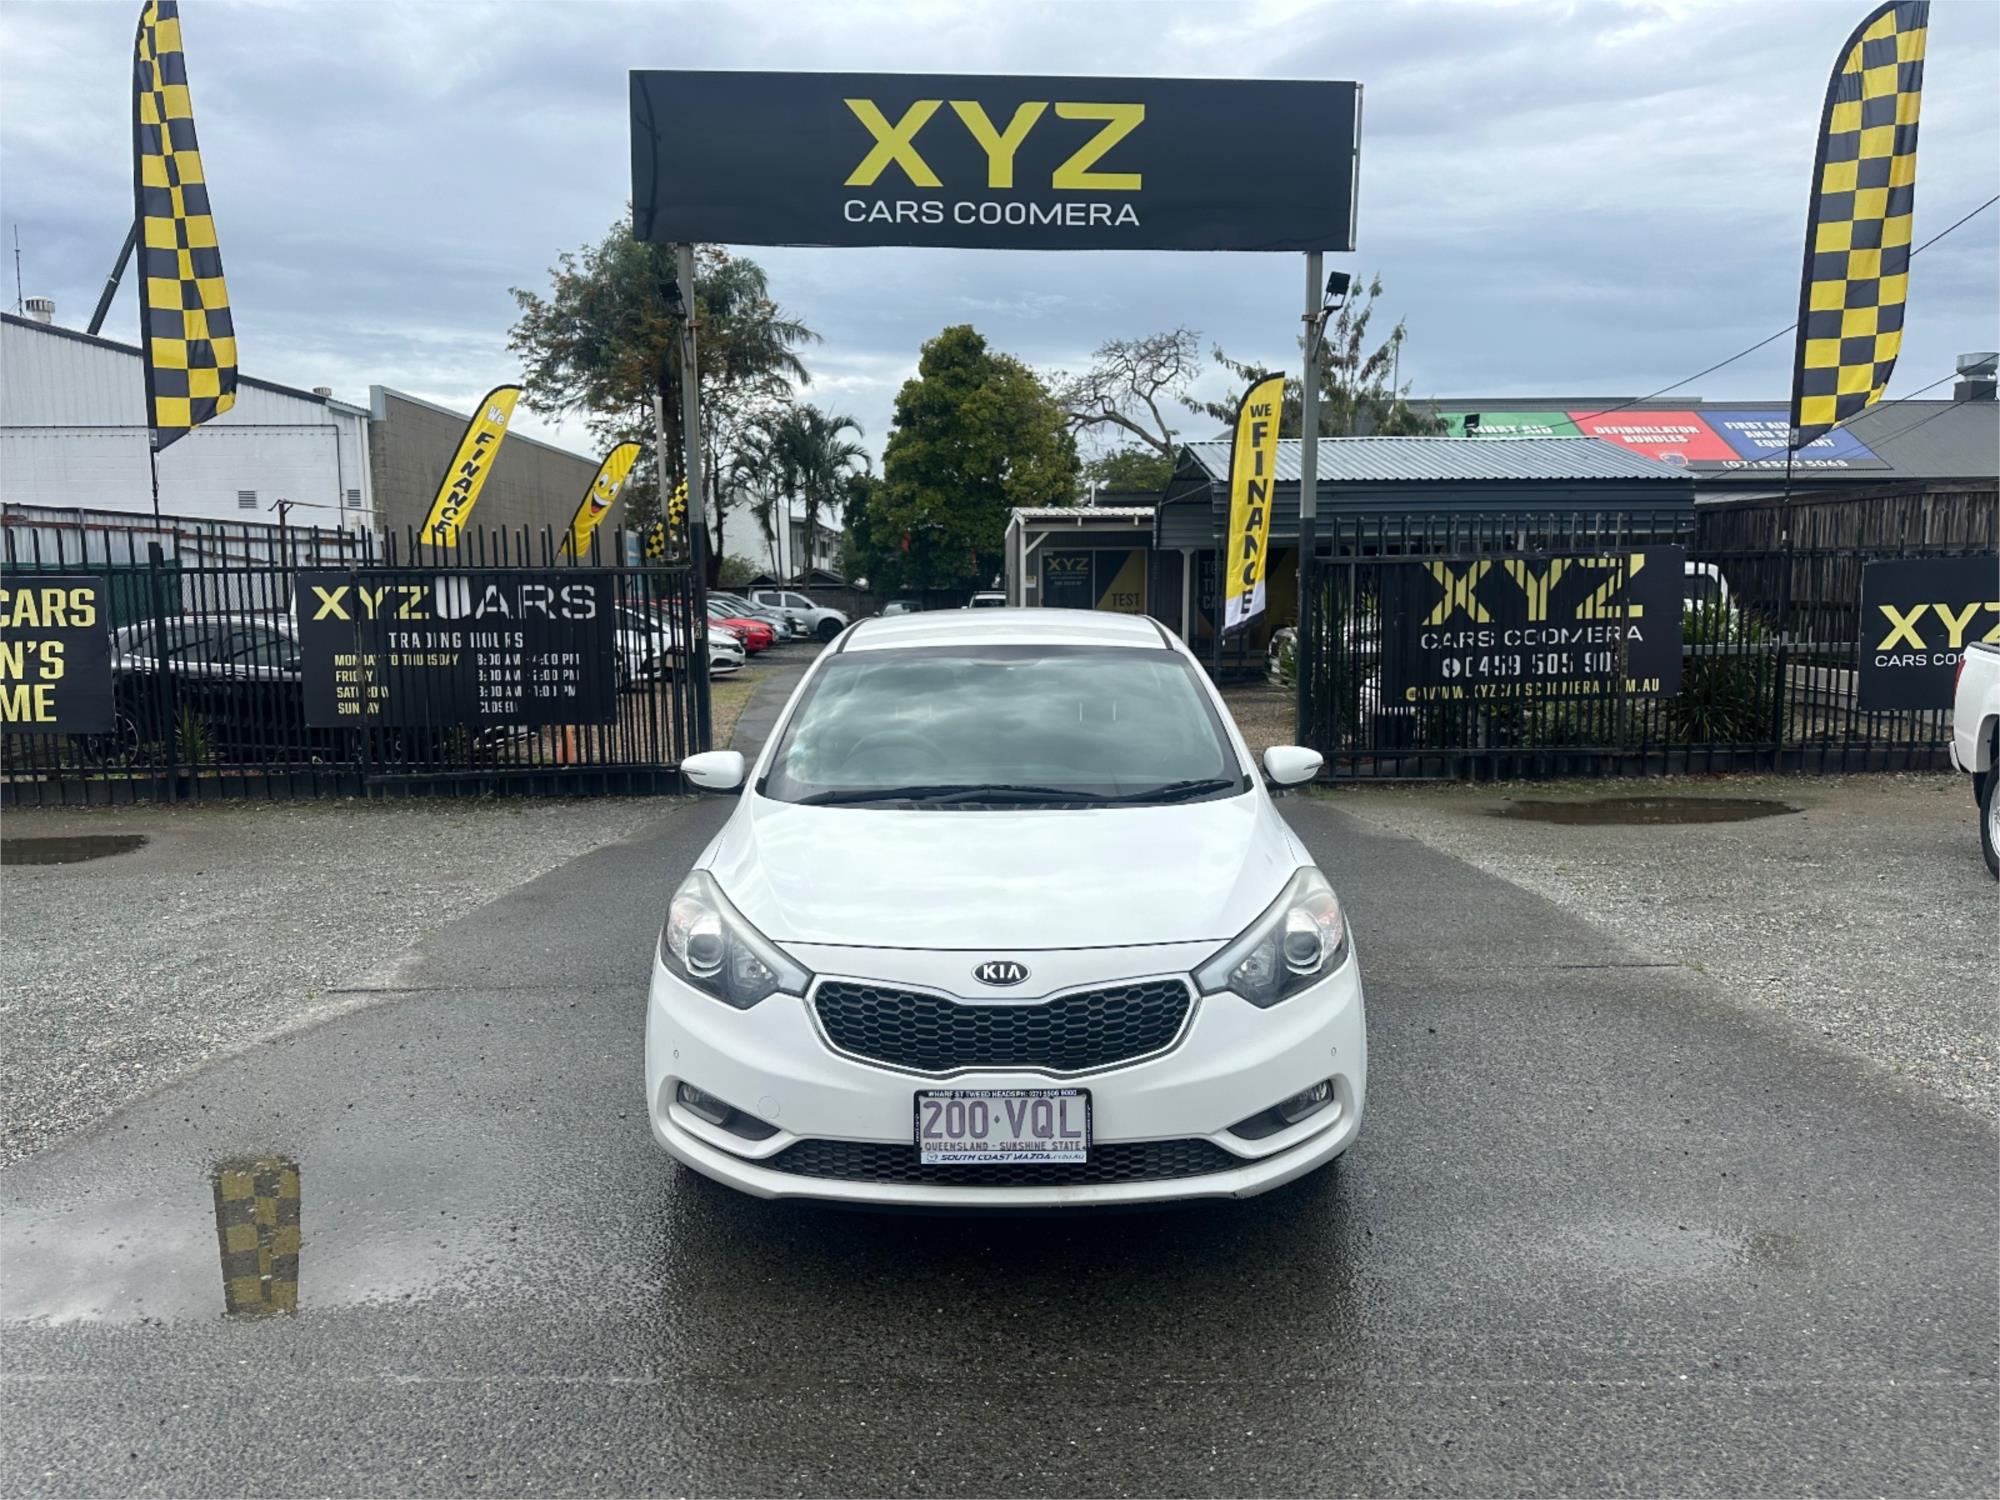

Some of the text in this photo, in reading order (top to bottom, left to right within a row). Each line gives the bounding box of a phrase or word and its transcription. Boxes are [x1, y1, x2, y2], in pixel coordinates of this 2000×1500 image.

[843, 98, 1146, 190] XYZ
[843, 200, 1140, 226] CARS COOMERA
[487, 406, 505, 425] We
[1250, 403, 1272, 418] WE
[1593, 426, 1700, 434] DEFIBRILLATOR
[1744, 430, 1773, 438] AND
[1622, 435, 1688, 443] BUNDLES
[1754, 438, 1836, 448] EQUIENT
[434, 432, 496, 535] FINANCE
[1240, 422, 1269, 614] FINANCE
[1048, 558, 1088, 571] XYZ
[1422, 553, 1645, 626] XYZ
[311, 585, 430, 620] XYZ
[1112, 593, 1140, 607] TEST
[389, 632, 462, 648] TRADING
[1421, 625, 1644, 649] CARS COOMERA
[1875, 655, 1927, 667] CARS
[335, 671, 373, 682] FRIDY
[338, 702, 379, 714] SUNAY
[983, 964, 1021, 979] KIA
[925, 1142, 989, 1151] QUEENSLAND
[999, 1141, 1046, 1151] SUNSHINE
[1052, 1140, 1080, 1150] STATE
[977, 1153, 1013, 1161] COAST
